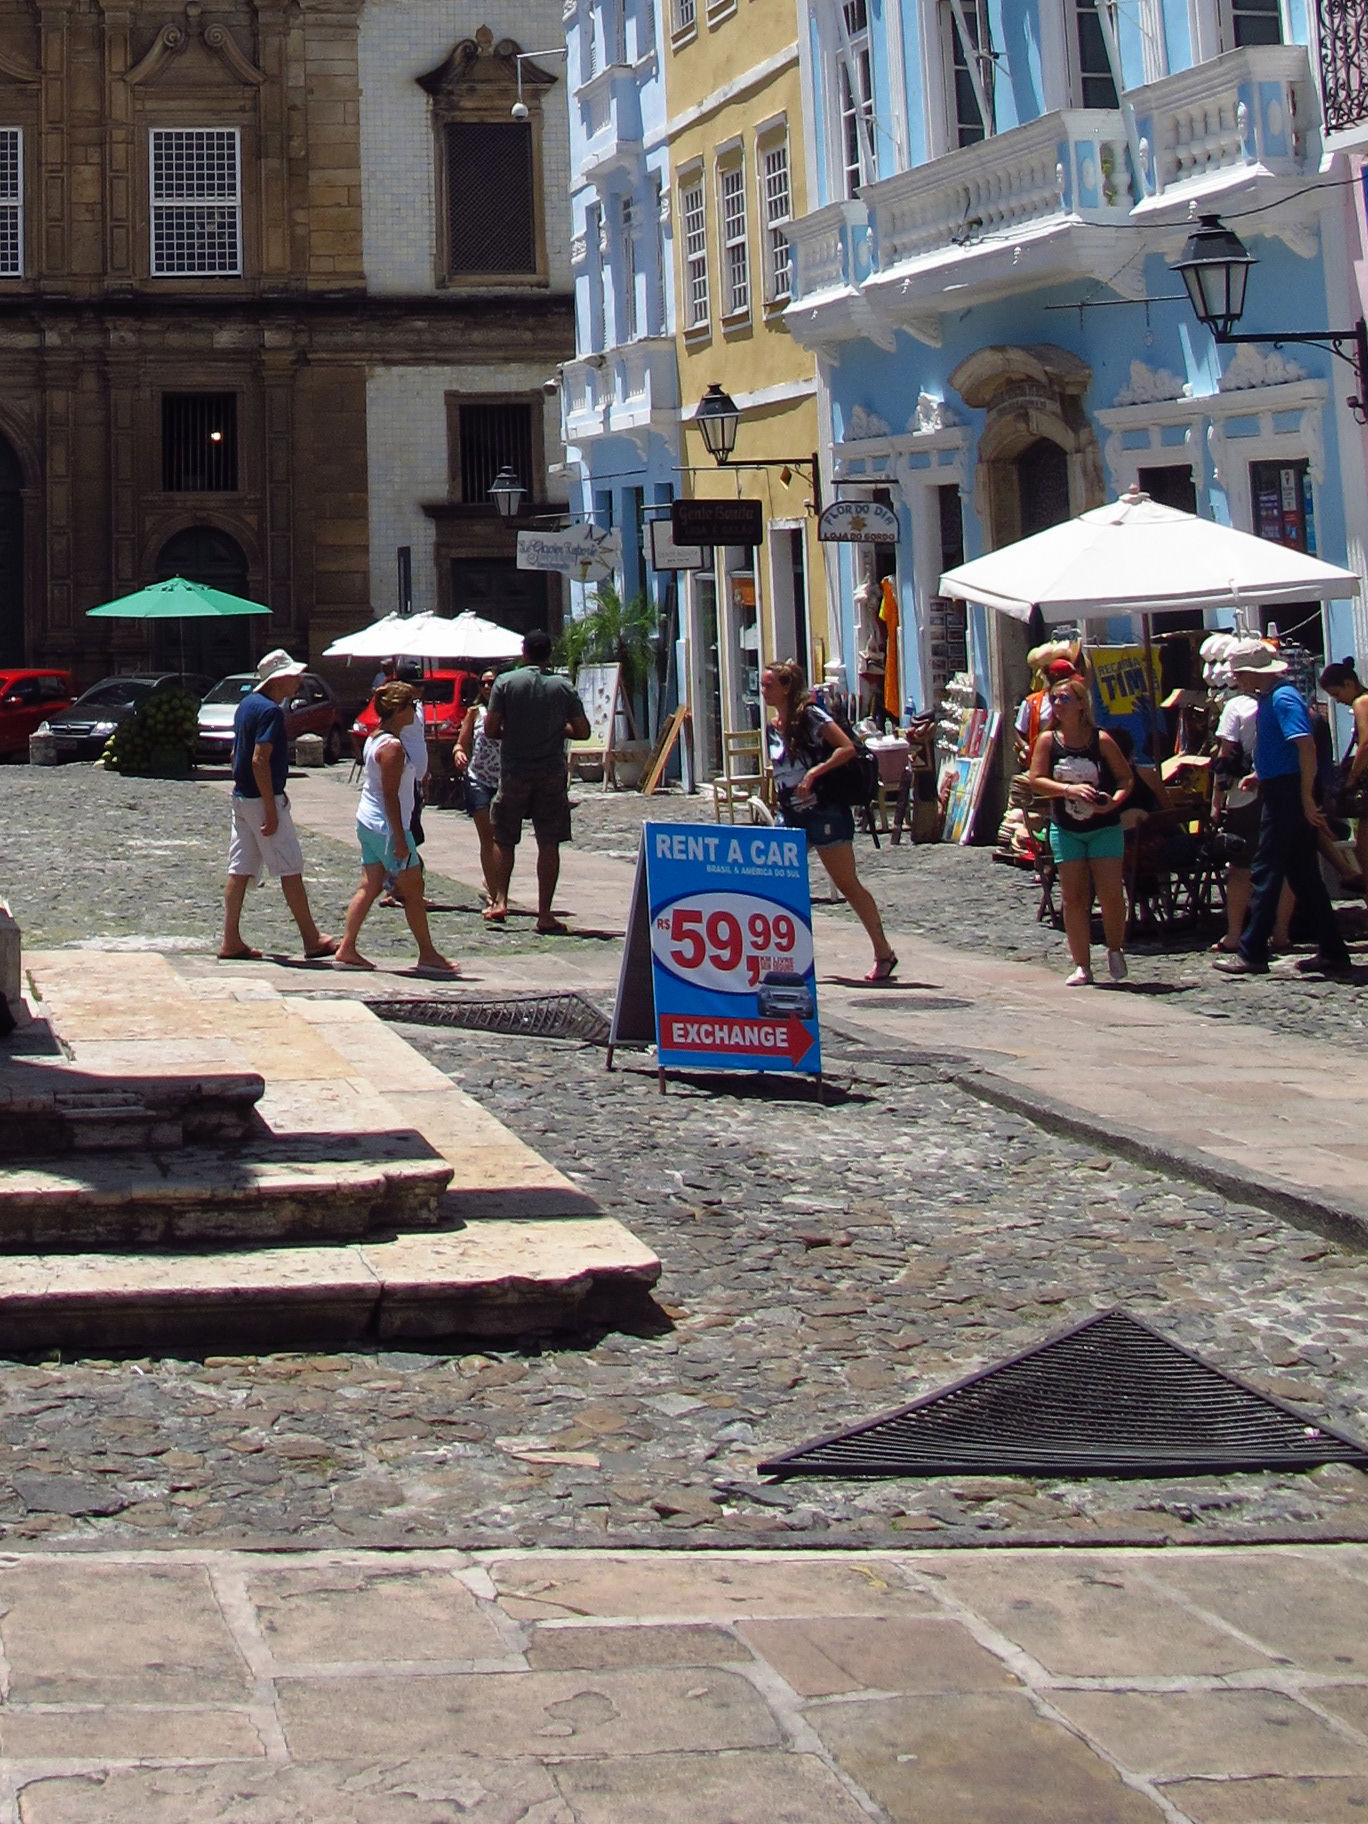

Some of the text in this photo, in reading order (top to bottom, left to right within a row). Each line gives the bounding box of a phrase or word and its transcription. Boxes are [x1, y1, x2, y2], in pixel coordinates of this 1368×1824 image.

[679, 505, 754, 526] Gente Bonita
[824, 504, 896, 526] FLOR DO DIA
[824, 532, 849, 540] LOJA
[1101, 667, 1148, 701] TIM
[656, 834, 800, 867] RENT A CAR
[706, 864, 732, 875] BRASIL
[774, 868, 785, 877] DO
[672, 1022, 789, 1048] EXCHANGE
